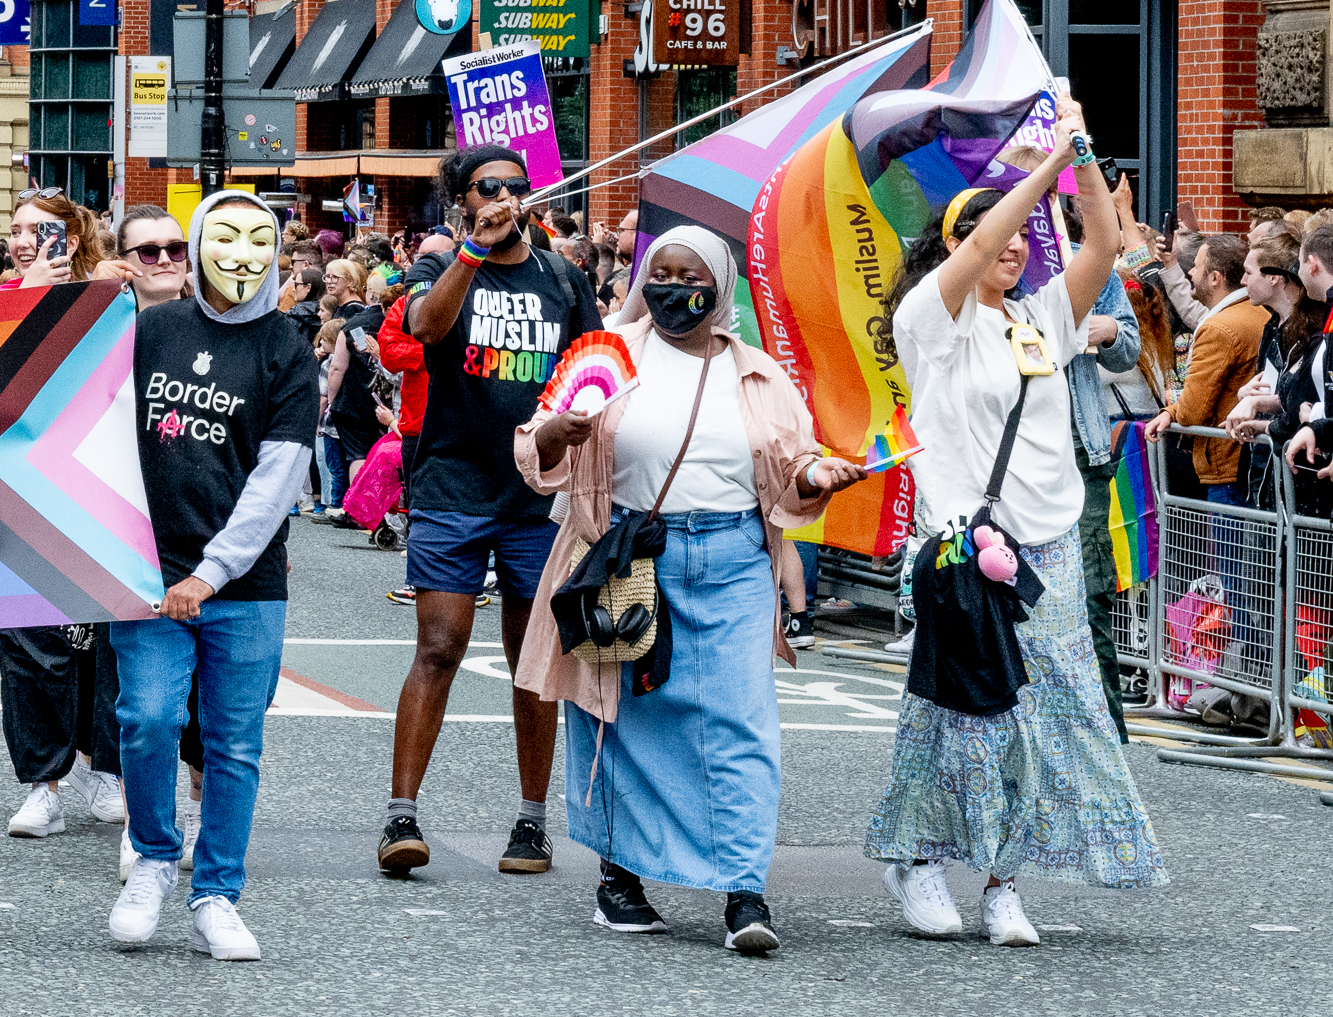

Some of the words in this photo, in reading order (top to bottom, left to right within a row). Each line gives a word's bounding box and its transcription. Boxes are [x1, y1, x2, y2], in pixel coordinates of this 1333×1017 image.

[493, 12, 576, 29] SUBWAY
[666, 40, 694, 49] CAFE
[696, 41, 704, 49] &
[706, 41, 728, 50] BAR
[148, 92, 165, 101] Stop
[450, 70, 527, 110] Trans
[461, 100, 549, 149] Rights
[473, 288, 544, 321] QUEER
[469, 314, 561, 354] MUSLIM
[145, 372, 245, 417] Border
[146, 402, 227, 445] Force
